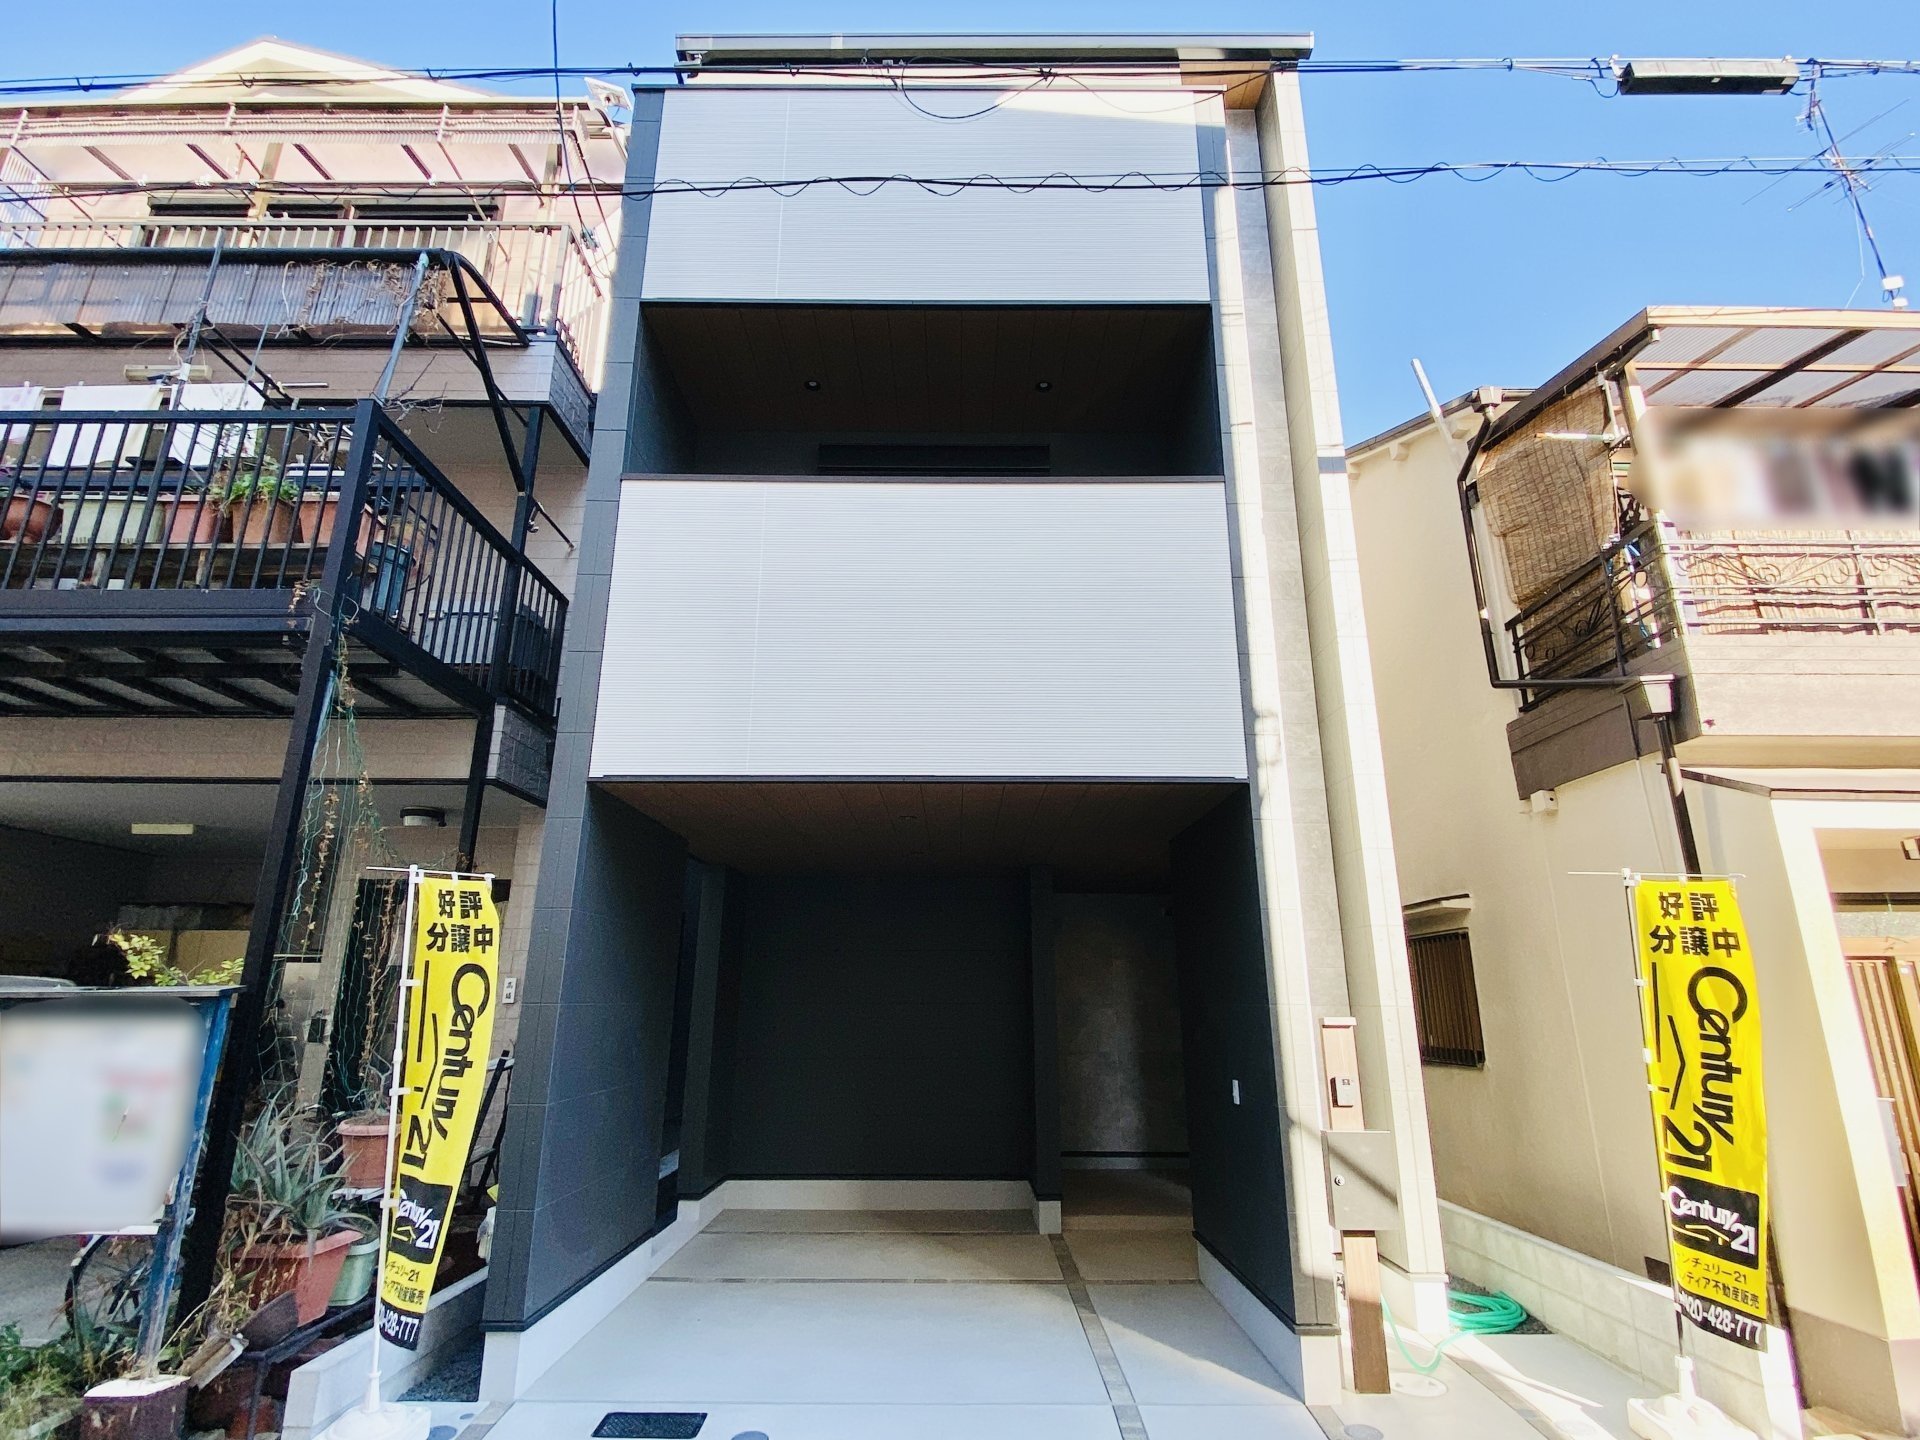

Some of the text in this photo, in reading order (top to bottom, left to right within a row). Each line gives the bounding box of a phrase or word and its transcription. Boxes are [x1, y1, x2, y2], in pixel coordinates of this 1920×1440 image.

[438, 889, 483, 919] 好評
[1658, 891, 1719, 922] 好評
[427, 922, 493, 954] 分譲中
[1649, 925, 1741, 958] 分譲中
[401, 963, 490, 1171] Century 21
[1661, 966, 1748, 1172] Century 21
[415, 1218, 441, 1250] 21
[1667, 1185, 1756, 1255] Century 21
